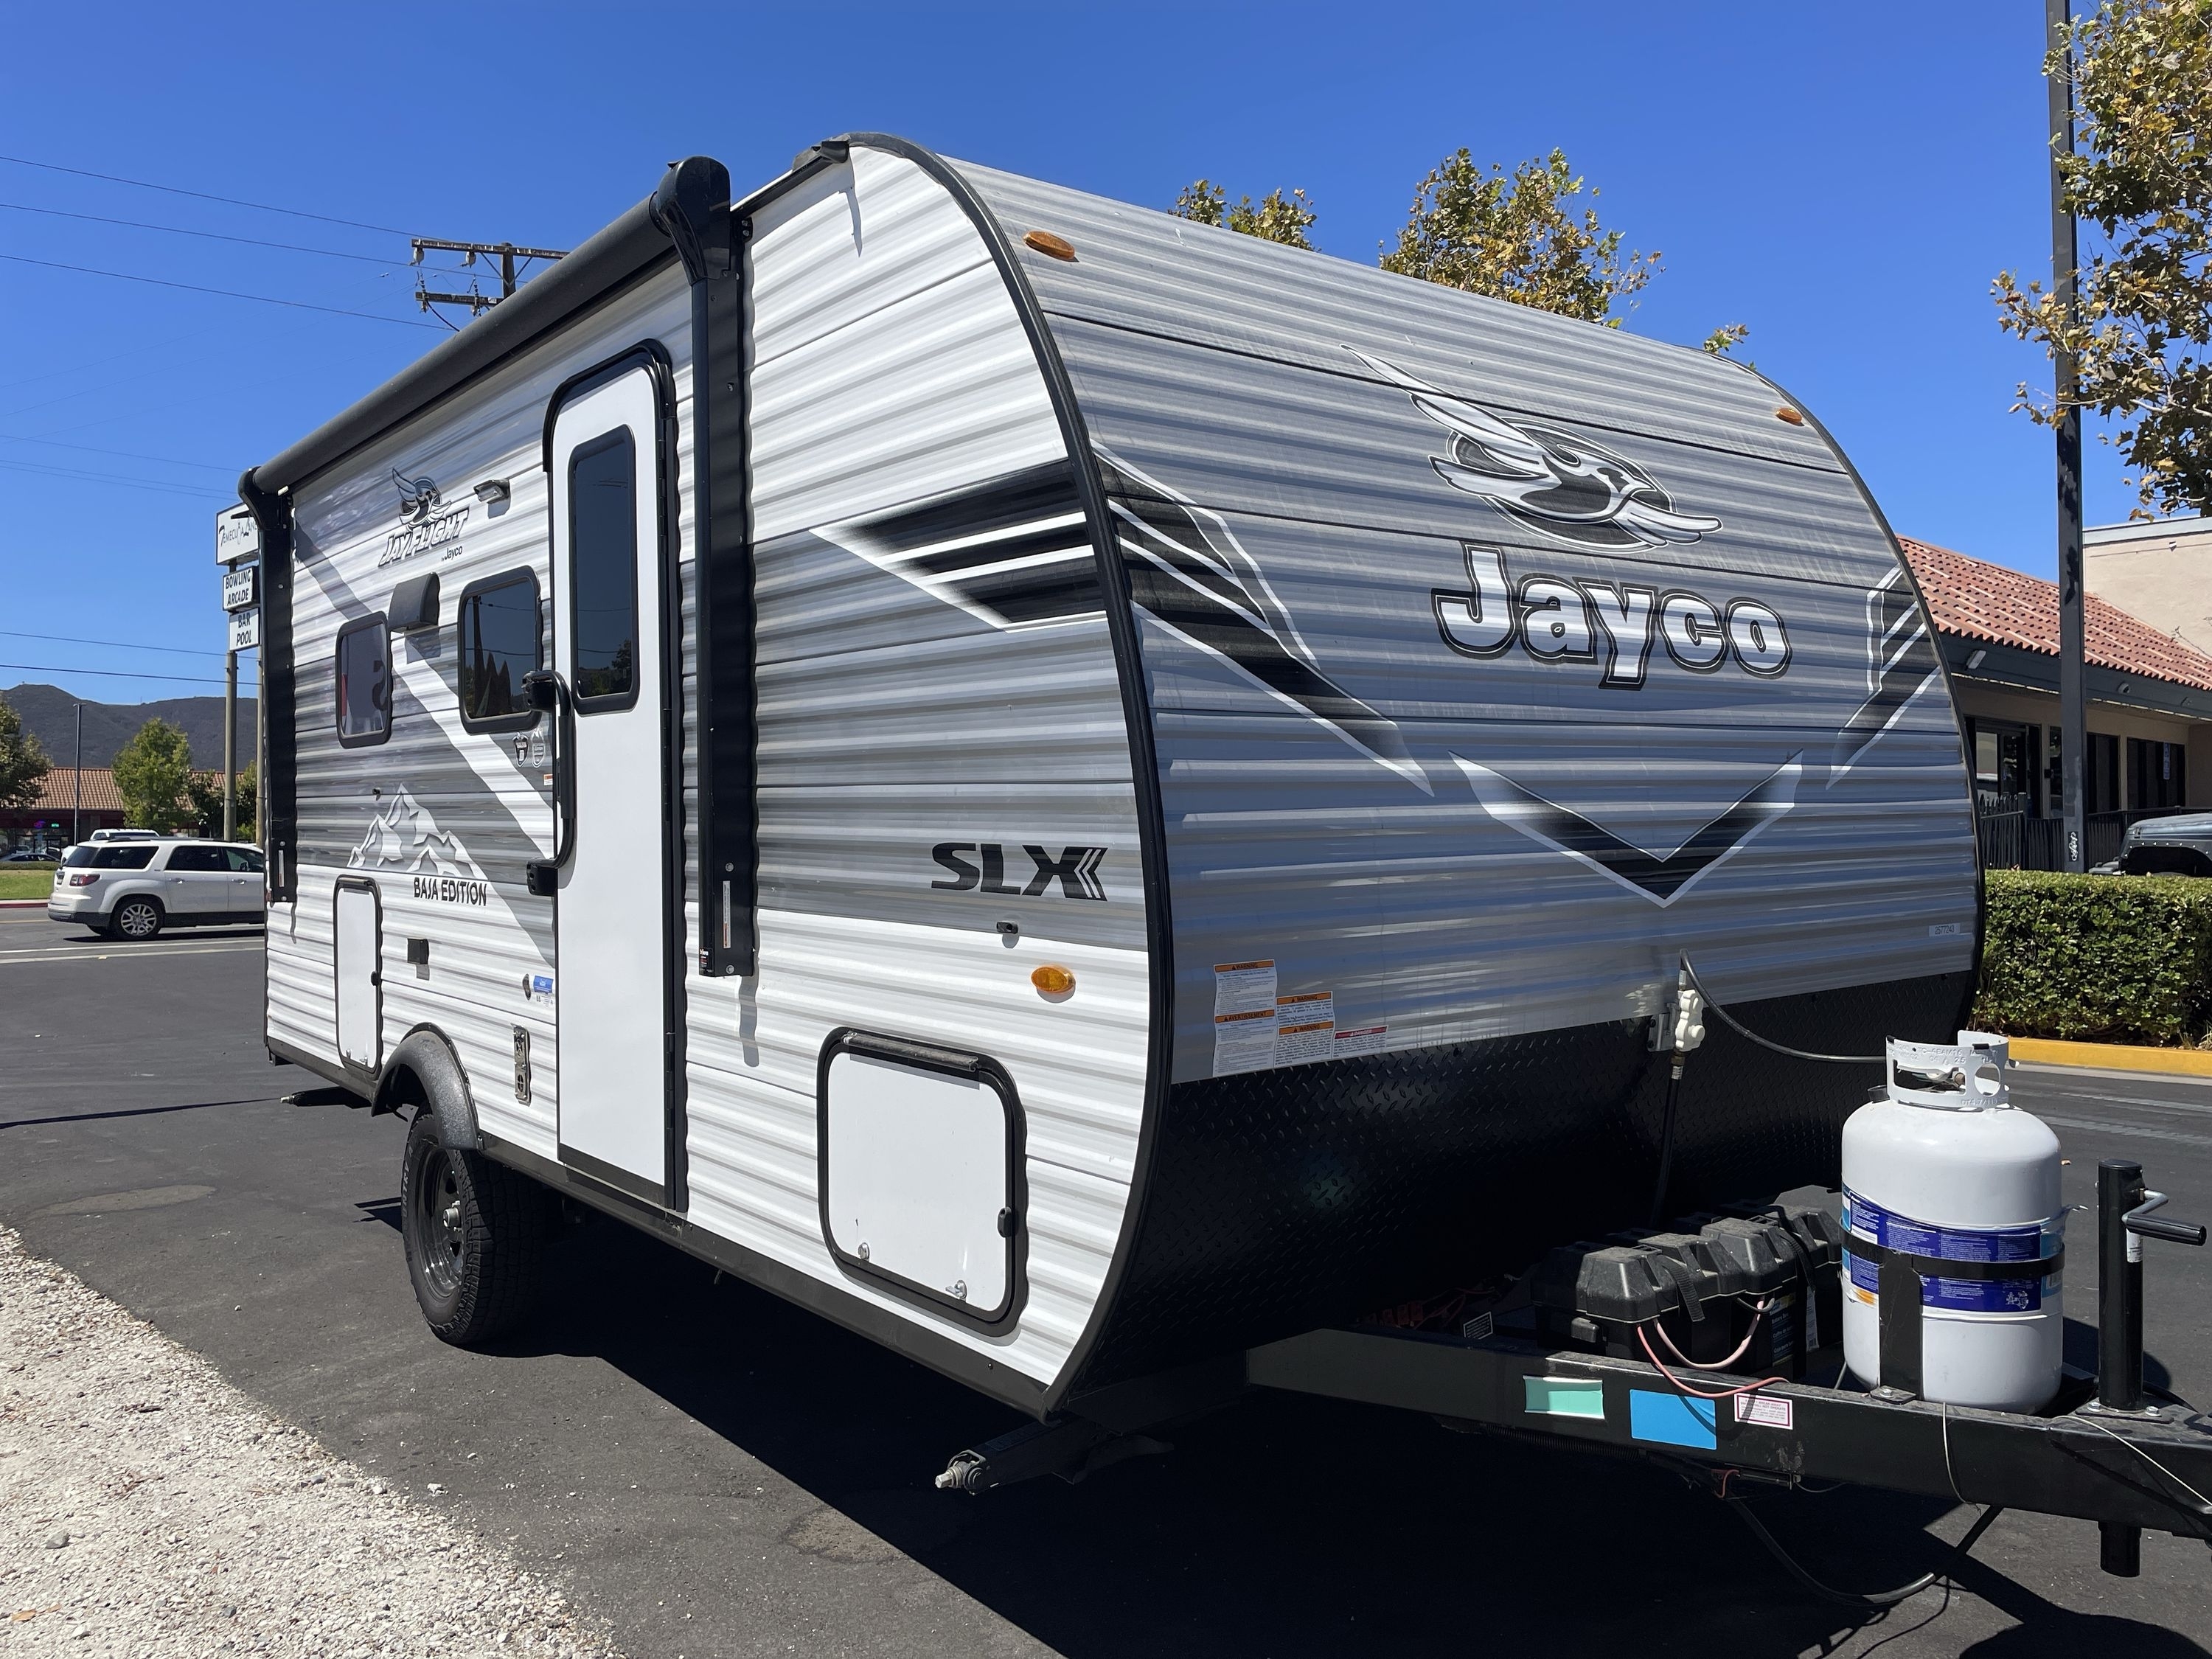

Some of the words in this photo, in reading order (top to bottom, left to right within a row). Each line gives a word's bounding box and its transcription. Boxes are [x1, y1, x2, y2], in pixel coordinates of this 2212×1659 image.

[408, 505, 470, 557] FLIGHT
[445, 546, 463, 560] Jayco
[225, 570, 251, 589] BOWLING
[227, 588, 249, 606] ARCADE
[237, 613, 251, 628] BAR
[1431, 541, 1792, 691] Jayco
[236, 630, 252, 647] POOL
[931, 842, 1107, 901] SLX
[414, 877, 439, 900] BAJA
[441, 879, 487, 906] EDITION
[1228, 1012, 1267, 1021] AVERTISSEMENT
